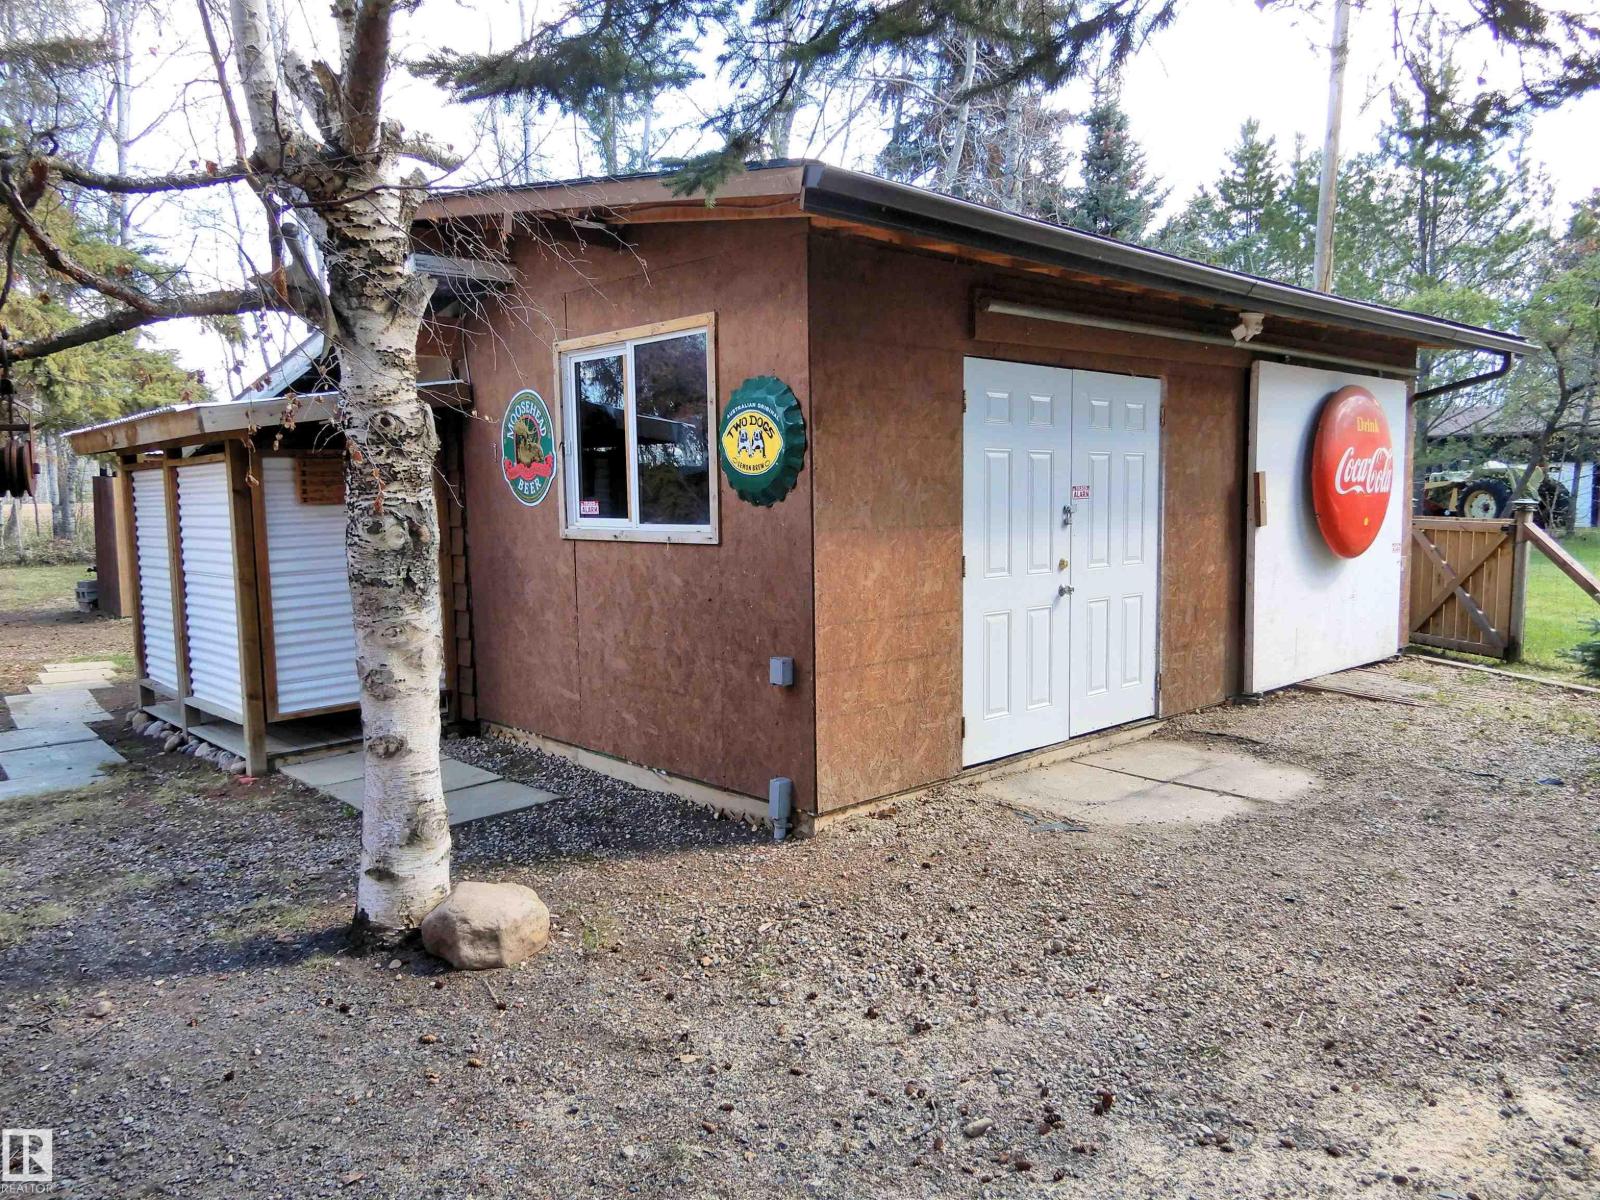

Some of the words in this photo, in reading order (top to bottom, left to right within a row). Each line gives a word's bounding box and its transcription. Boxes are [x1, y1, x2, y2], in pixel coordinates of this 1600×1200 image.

[507, 401, 547, 439] MOOSEHEAD
[727, 403, 756, 419] AUSTRALIAN
[758, 403, 780, 421] ORIGINAL
[726, 416, 748, 439] TWO
[749, 415, 775, 439] DOGS
[1356, 416, 1380, 433] Drink
[738, 461, 752, 471] LEMON
[752, 462, 765, 472] BREW
[518, 478, 542, 495] BEER
